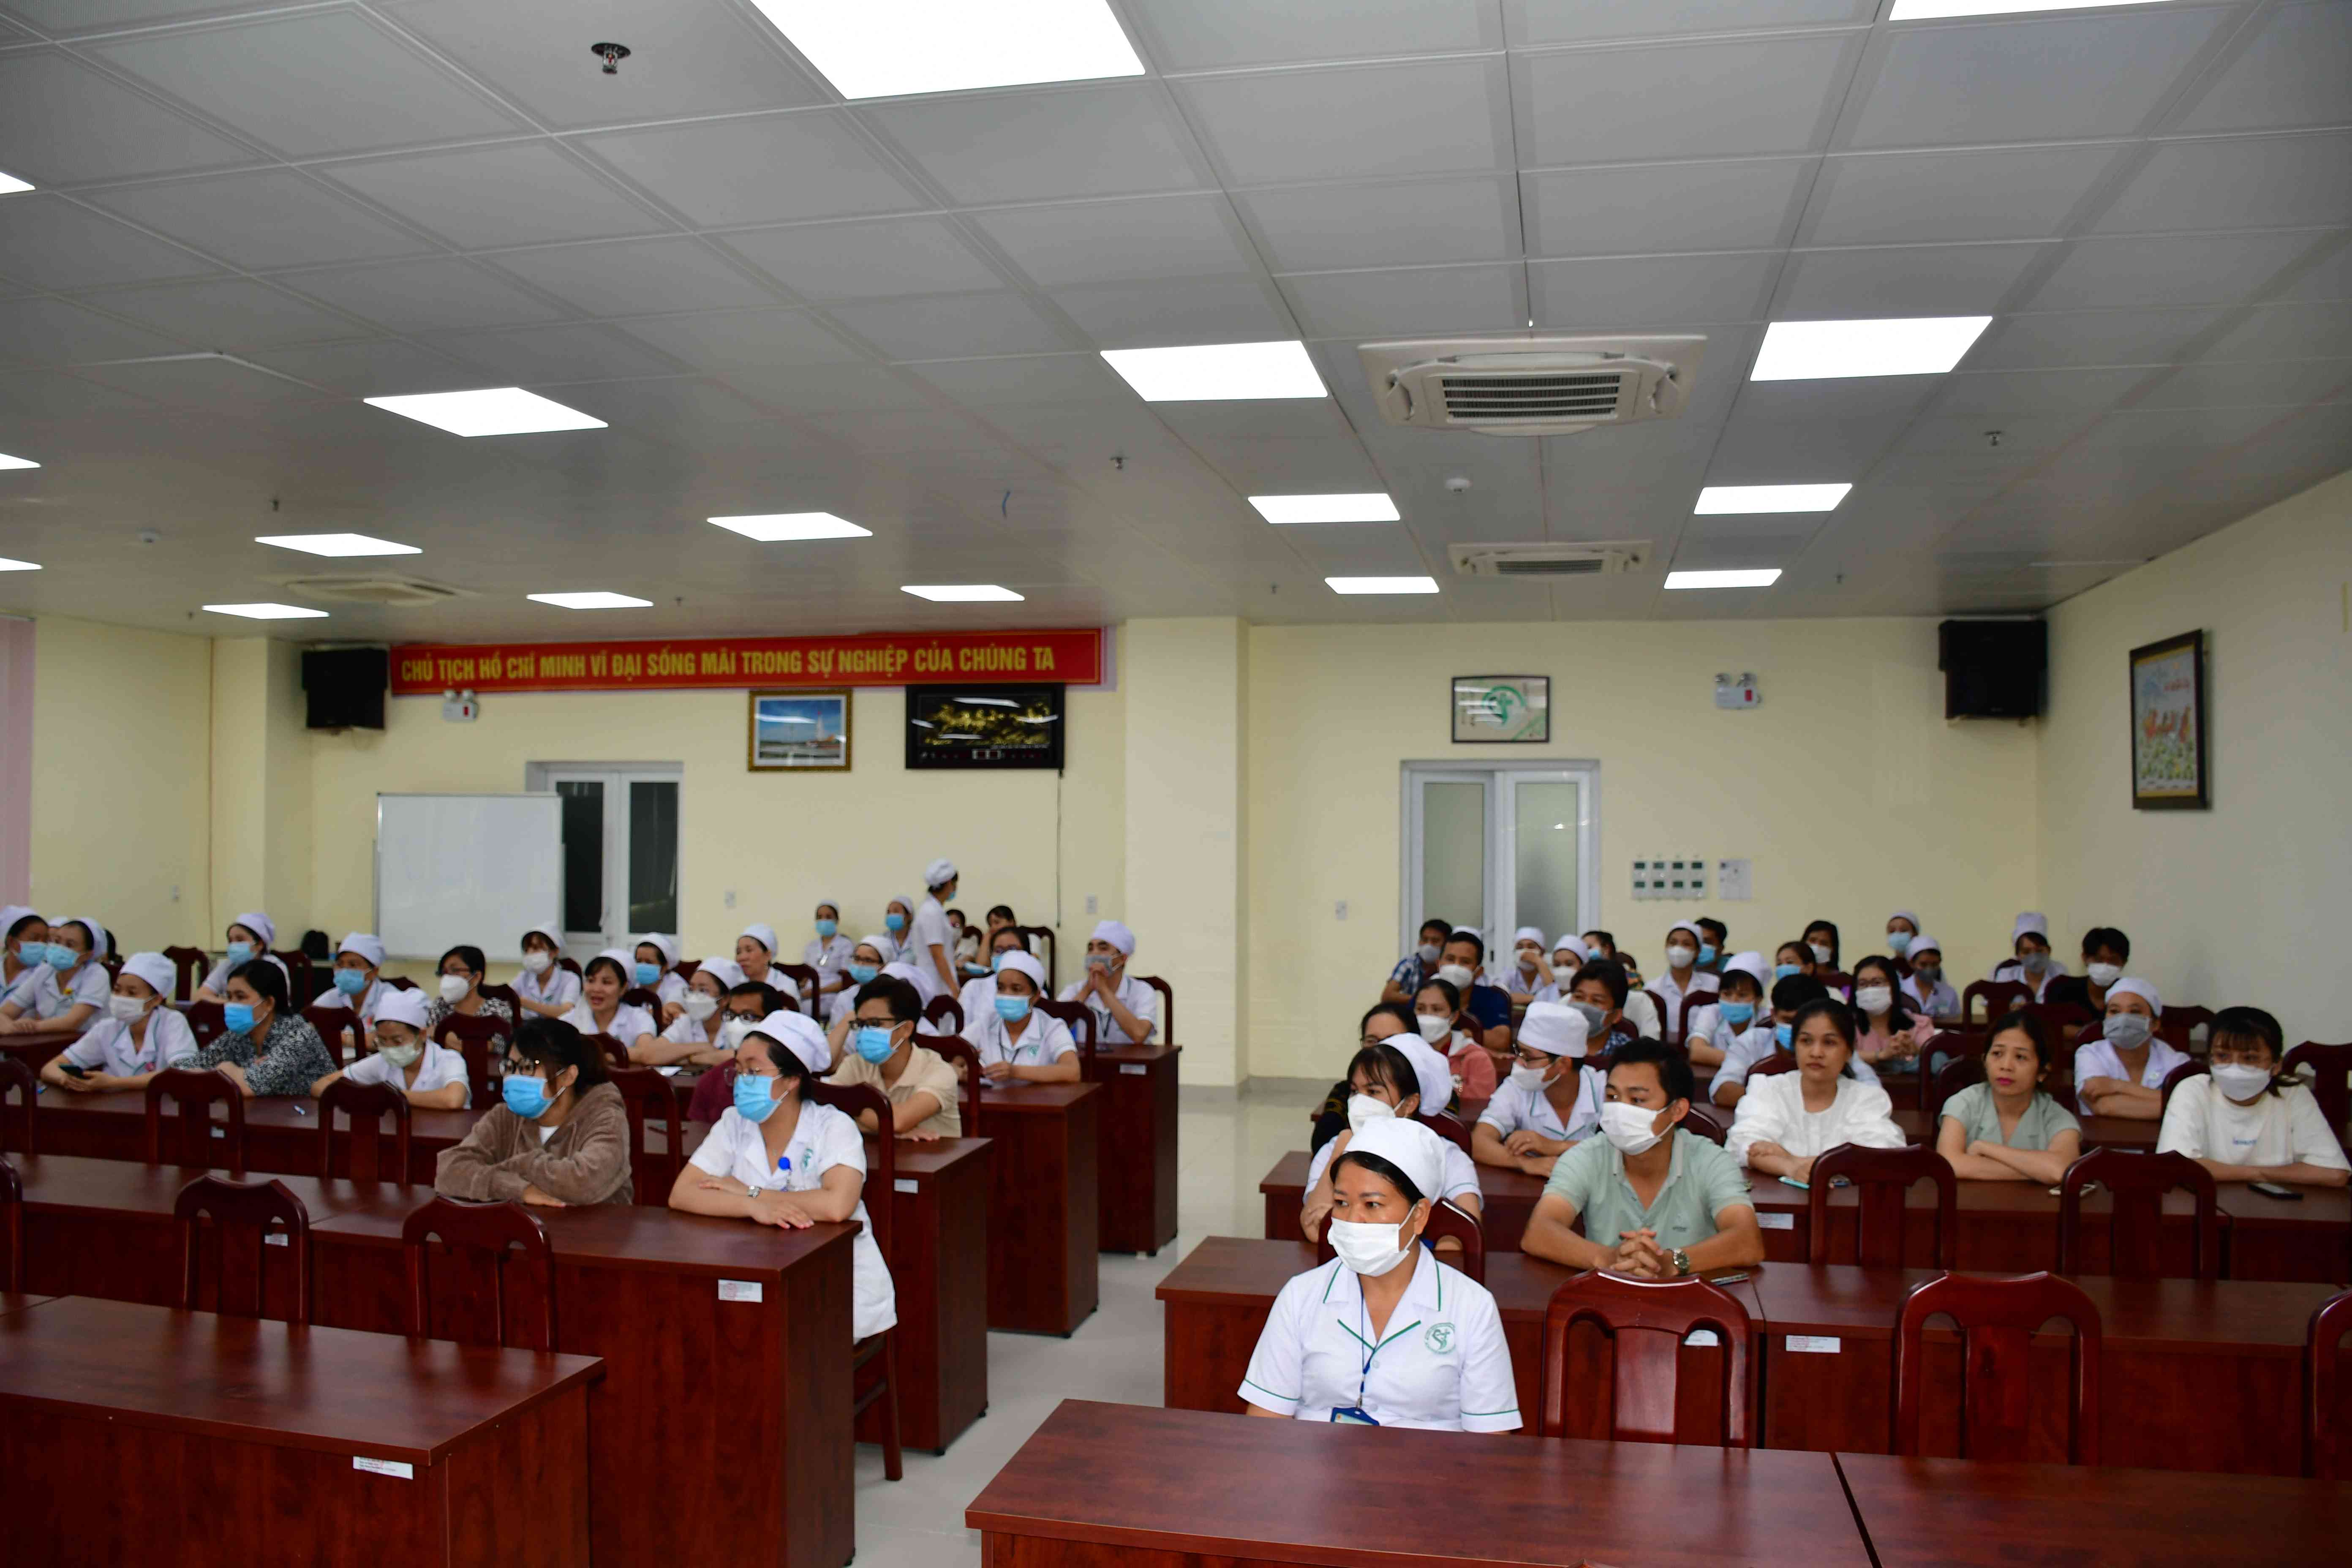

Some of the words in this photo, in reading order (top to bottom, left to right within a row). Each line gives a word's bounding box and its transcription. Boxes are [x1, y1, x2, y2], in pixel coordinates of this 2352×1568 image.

[438, 658, 474, 685] TỊCH
[506, 651, 534, 678] CHÍ
[540, 654, 585, 678] MINH
[612, 653, 641, 681] ĐẠI
[647, 645, 695, 675] SỐNG
[742, 651, 802, 674] TRONG
[807, 648, 834, 679] SỰ
[839, 645, 908, 677] NGHIỆP
[914, 641, 953, 672] CỦA
[959, 643, 1027, 671] CHÚNG
[1032, 647, 1055, 670] TA
